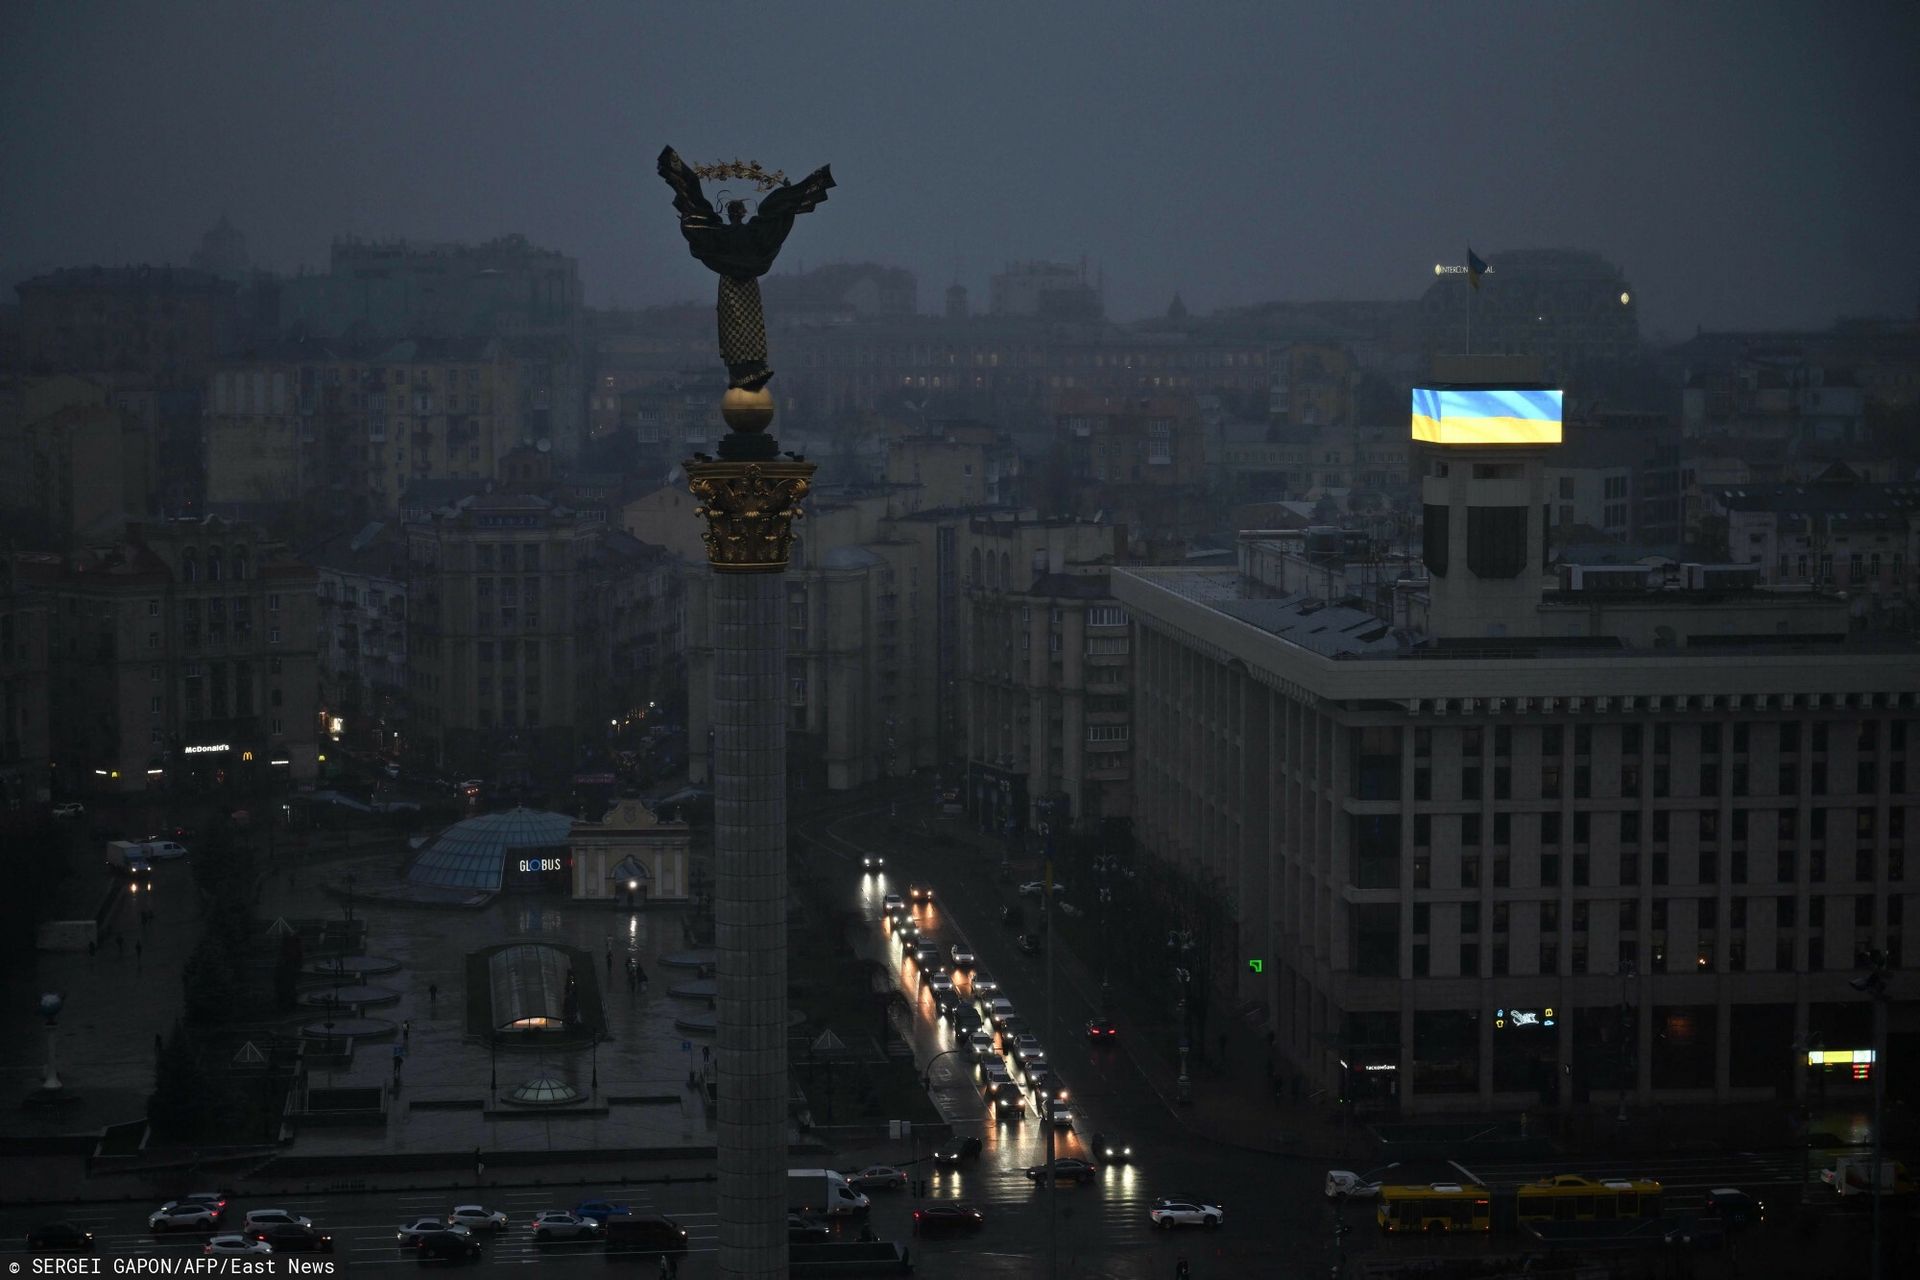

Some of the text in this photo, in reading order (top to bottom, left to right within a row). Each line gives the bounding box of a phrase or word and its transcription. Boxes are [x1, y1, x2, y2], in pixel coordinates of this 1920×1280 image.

[1440, 265, 1495, 274] INTERCONAL
[185, 744, 230, 754] McDonald's
[519, 858, 561, 872] GLOBUS
